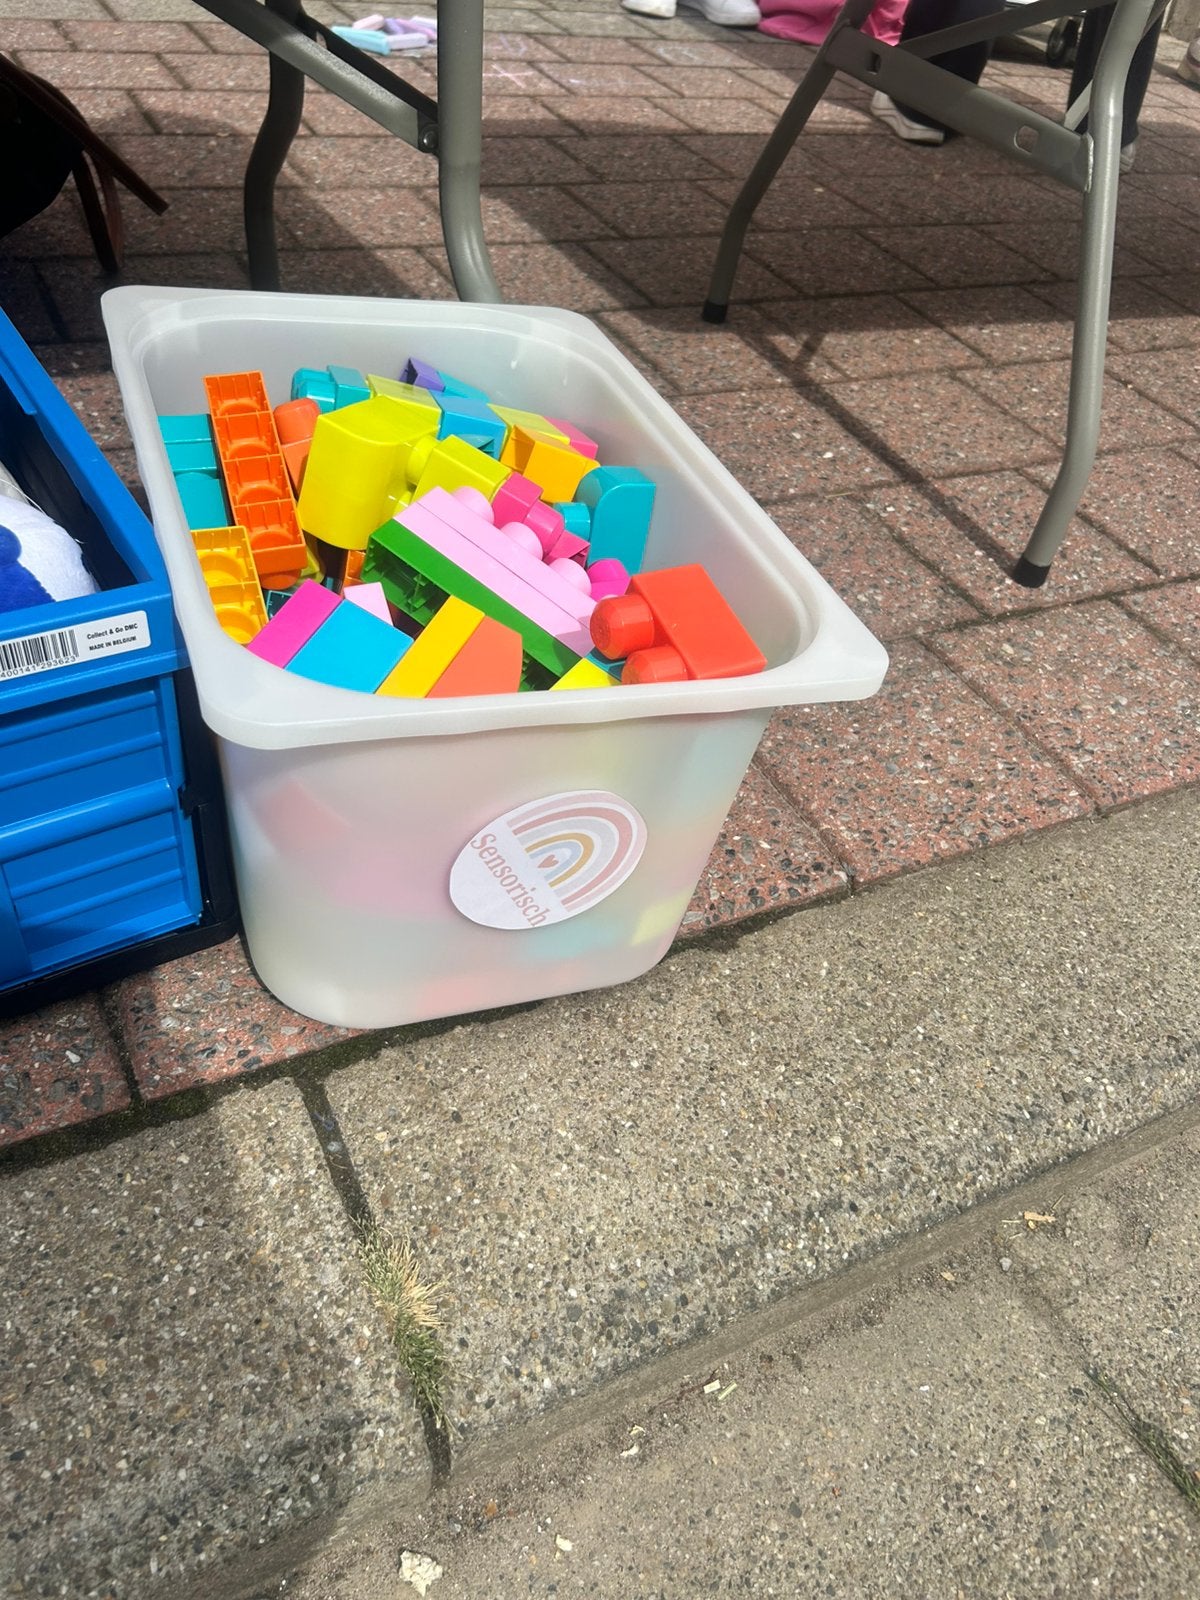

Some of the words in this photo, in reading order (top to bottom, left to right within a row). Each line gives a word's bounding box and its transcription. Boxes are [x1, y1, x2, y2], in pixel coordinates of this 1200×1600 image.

[87, 630, 108, 640] Collect
[124, 623, 138, 631] DMC
[89, 643, 105, 651] MADE
[112, 636, 137, 646] BELGIUM
[470, 832, 550, 928] Sensorisch
